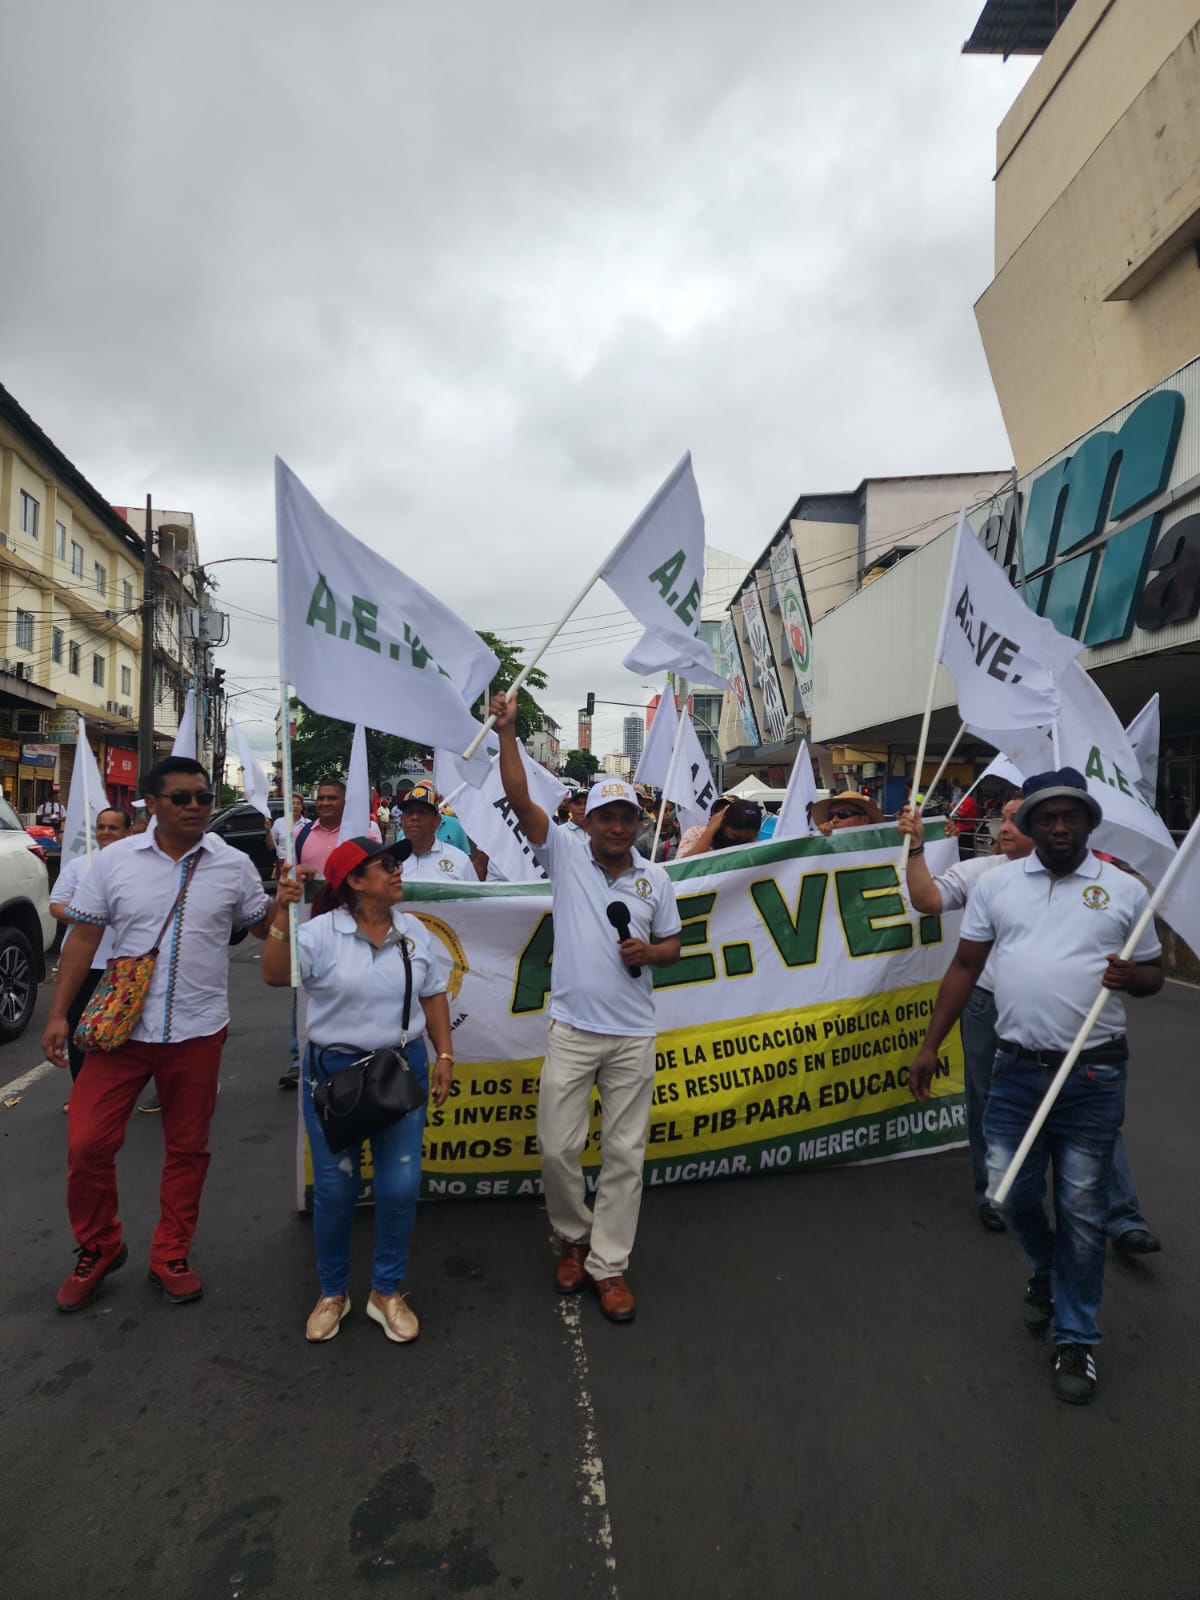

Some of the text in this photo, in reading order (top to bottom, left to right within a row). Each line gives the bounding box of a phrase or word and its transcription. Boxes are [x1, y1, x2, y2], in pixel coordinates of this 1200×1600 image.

[454, 1104, 537, 1126] INVERS
[685, 1057, 798, 1099] RESULTADOS
[804, 1051, 825, 1073] EN
[832, 1029, 926, 1067] EDUCACIÓN"
[471, 1078, 512, 1096] LOS
[655, 1049, 678, 1072] DE
[683, 1044, 707, 1066] LA
[712, 1020, 817, 1061] EDUCACIÓN
[824, 1008, 891, 1040] PÚBLICA
[895, 999, 934, 1022] OFICI
[648, 1116, 683, 1144] EL
[693, 1109, 737, 1137] PIB
[745, 1093, 811, 1125] PARA
[819, 1055, 950, 1108] EDUCACN
[428, 1178, 467, 1196] NO
[475, 1178, 510, 1195] SE
[650, 1154, 751, 1186] LUCHAR,
[759, 1145, 792, 1169] NO
[798, 1124, 880, 1162] MERECE
